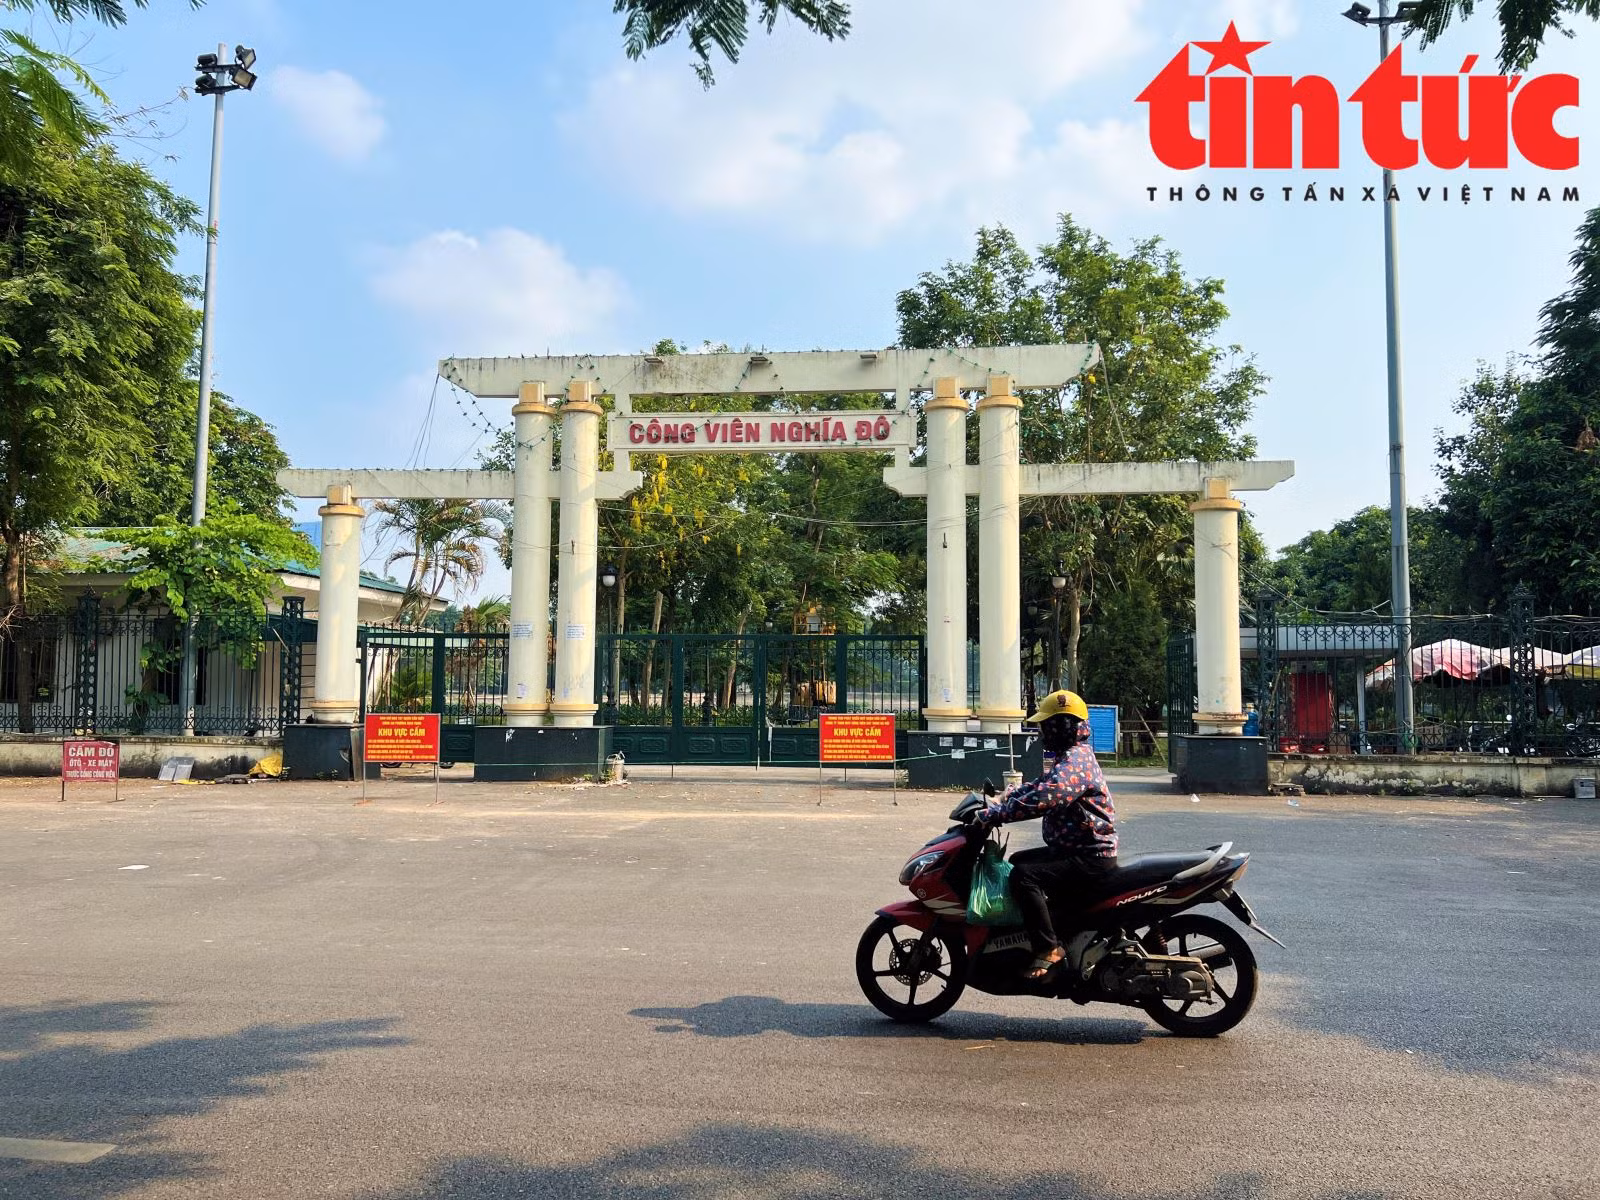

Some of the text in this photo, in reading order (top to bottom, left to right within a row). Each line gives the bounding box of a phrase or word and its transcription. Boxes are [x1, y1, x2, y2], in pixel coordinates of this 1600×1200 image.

[629, 415, 891, 444] CÔNG VIÊN NGHĨA ĐÔ
[378, 726, 426, 738] KHU VỰC CẤM
[834, 726, 881, 738] KHU VỰC CẤM
[87, 759, 97, 767] XE
[98, 758, 113, 767] MÁY
[1115, 885, 1168, 907] NOUVO
